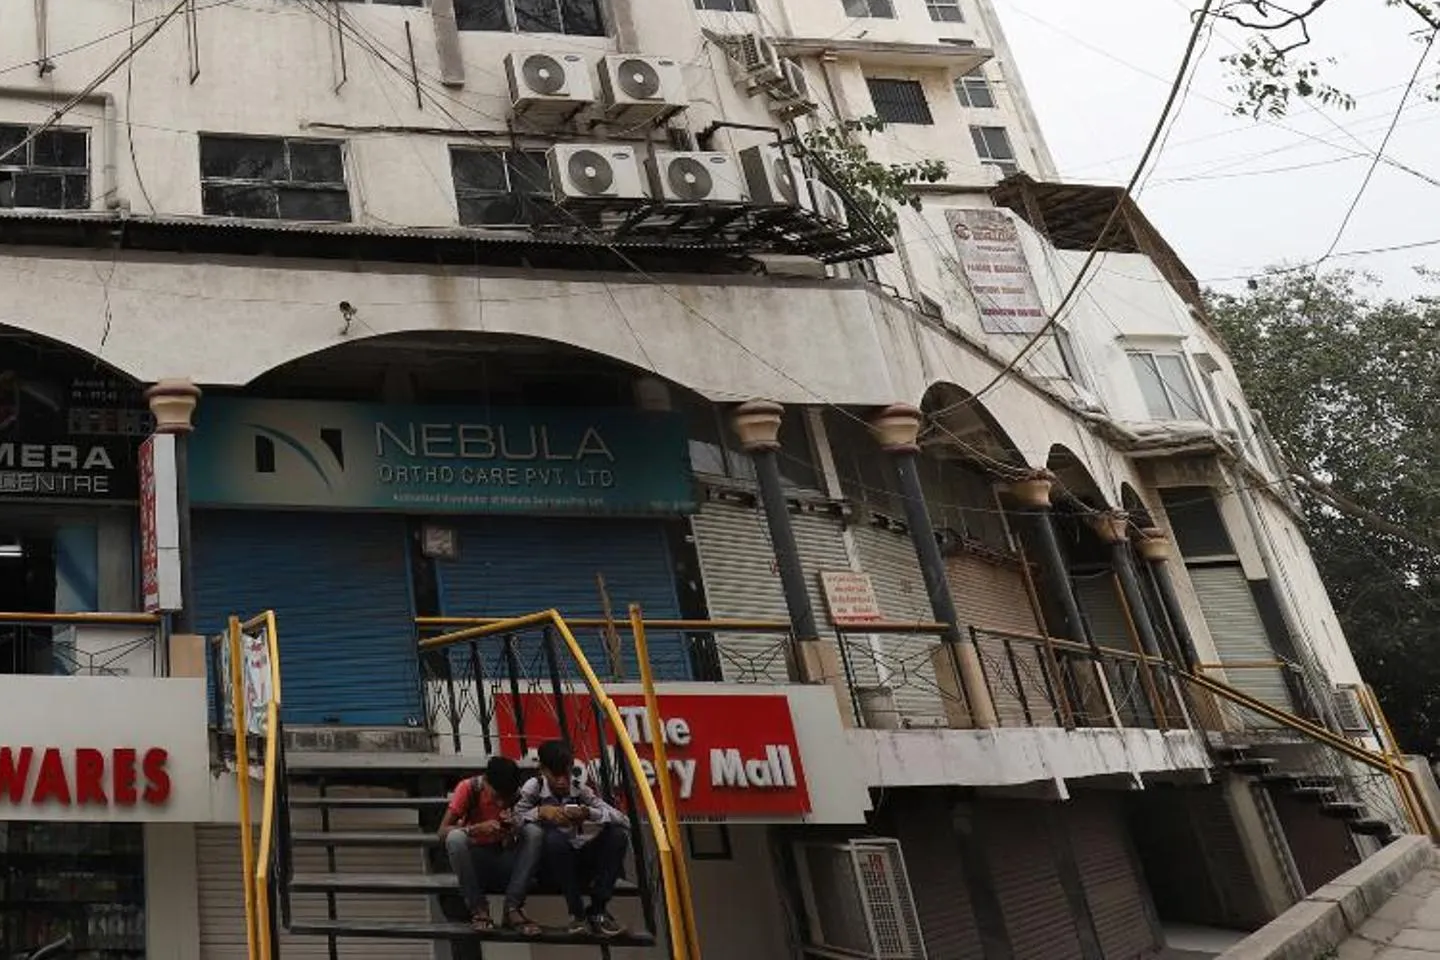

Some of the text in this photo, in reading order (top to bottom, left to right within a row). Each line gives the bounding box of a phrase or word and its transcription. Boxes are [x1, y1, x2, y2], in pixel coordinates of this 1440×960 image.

[375, 421, 615, 461] NEBULA
[378, 464, 453, 484] ORTHO
[461, 466, 519, 486] CARE
[525, 467, 568, 486] PVT.
[619, 705, 691, 746] The
[710, 744, 798, 788] Mall
